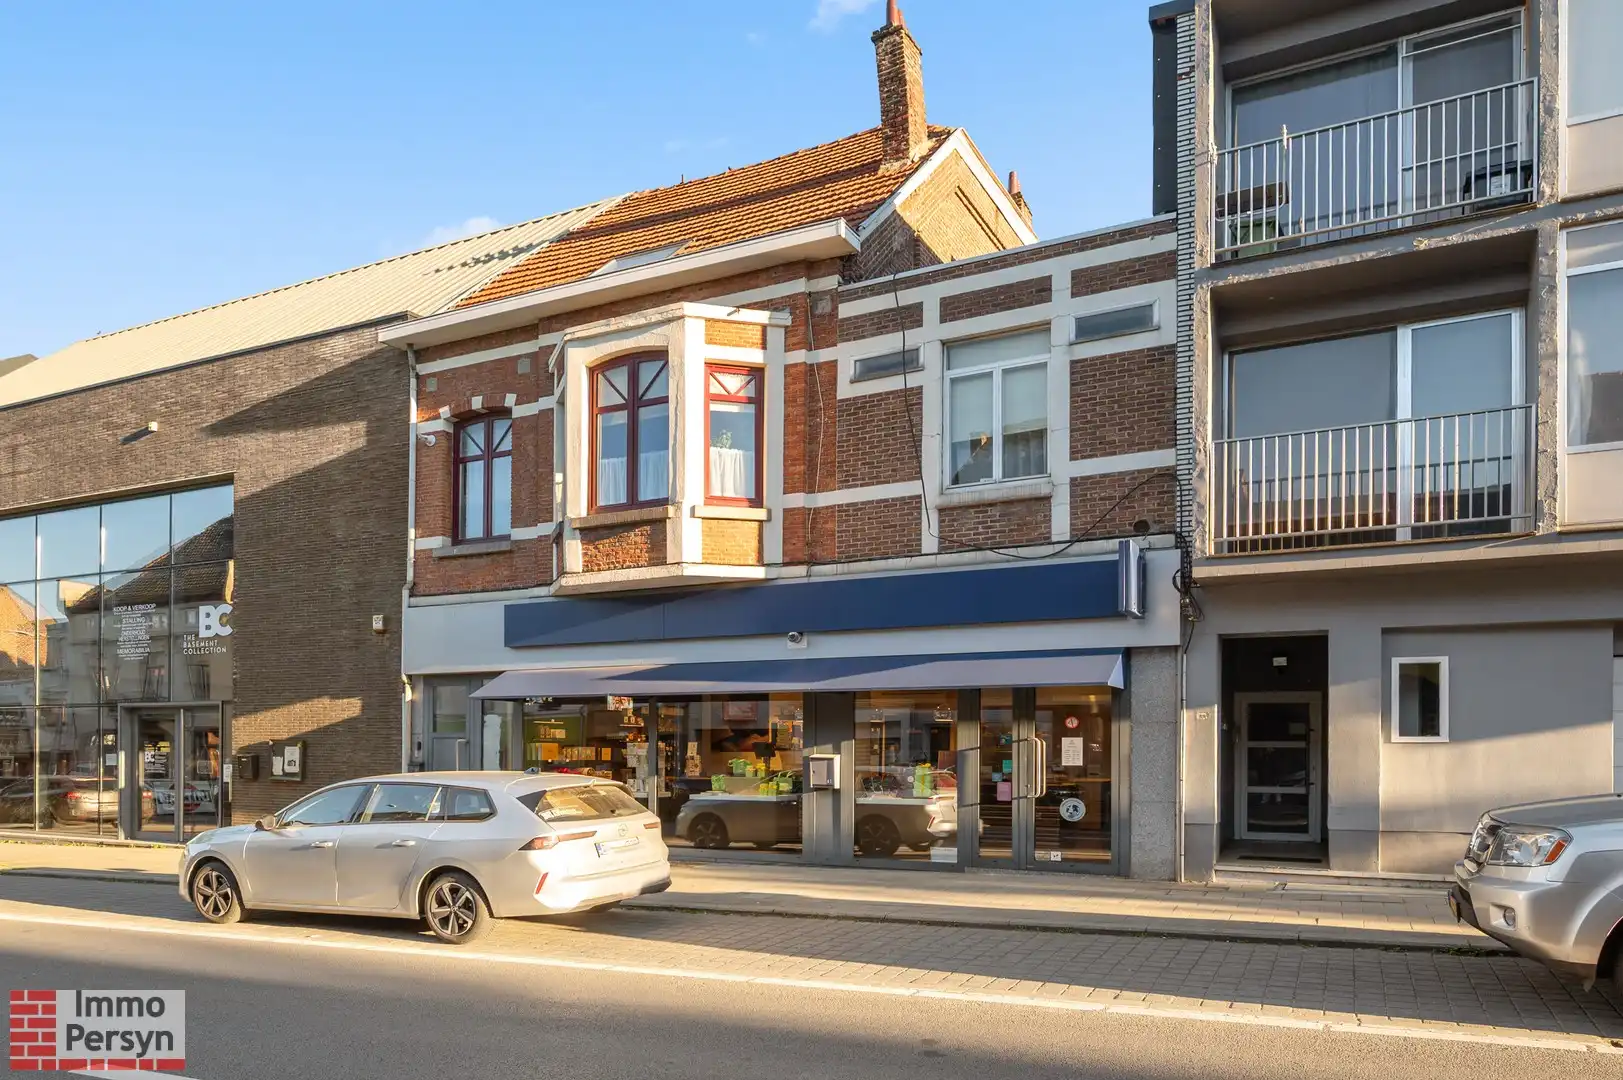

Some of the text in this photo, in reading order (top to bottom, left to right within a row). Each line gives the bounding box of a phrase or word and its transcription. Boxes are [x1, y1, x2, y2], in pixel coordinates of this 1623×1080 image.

[132, 603, 156, 611] VERKOOP
[122, 616, 146, 624] STALLING
[199, 603, 233, 638] BC
[183, 639, 218, 649] BASEMENT
[183, 646, 227, 655] COLLECTION
